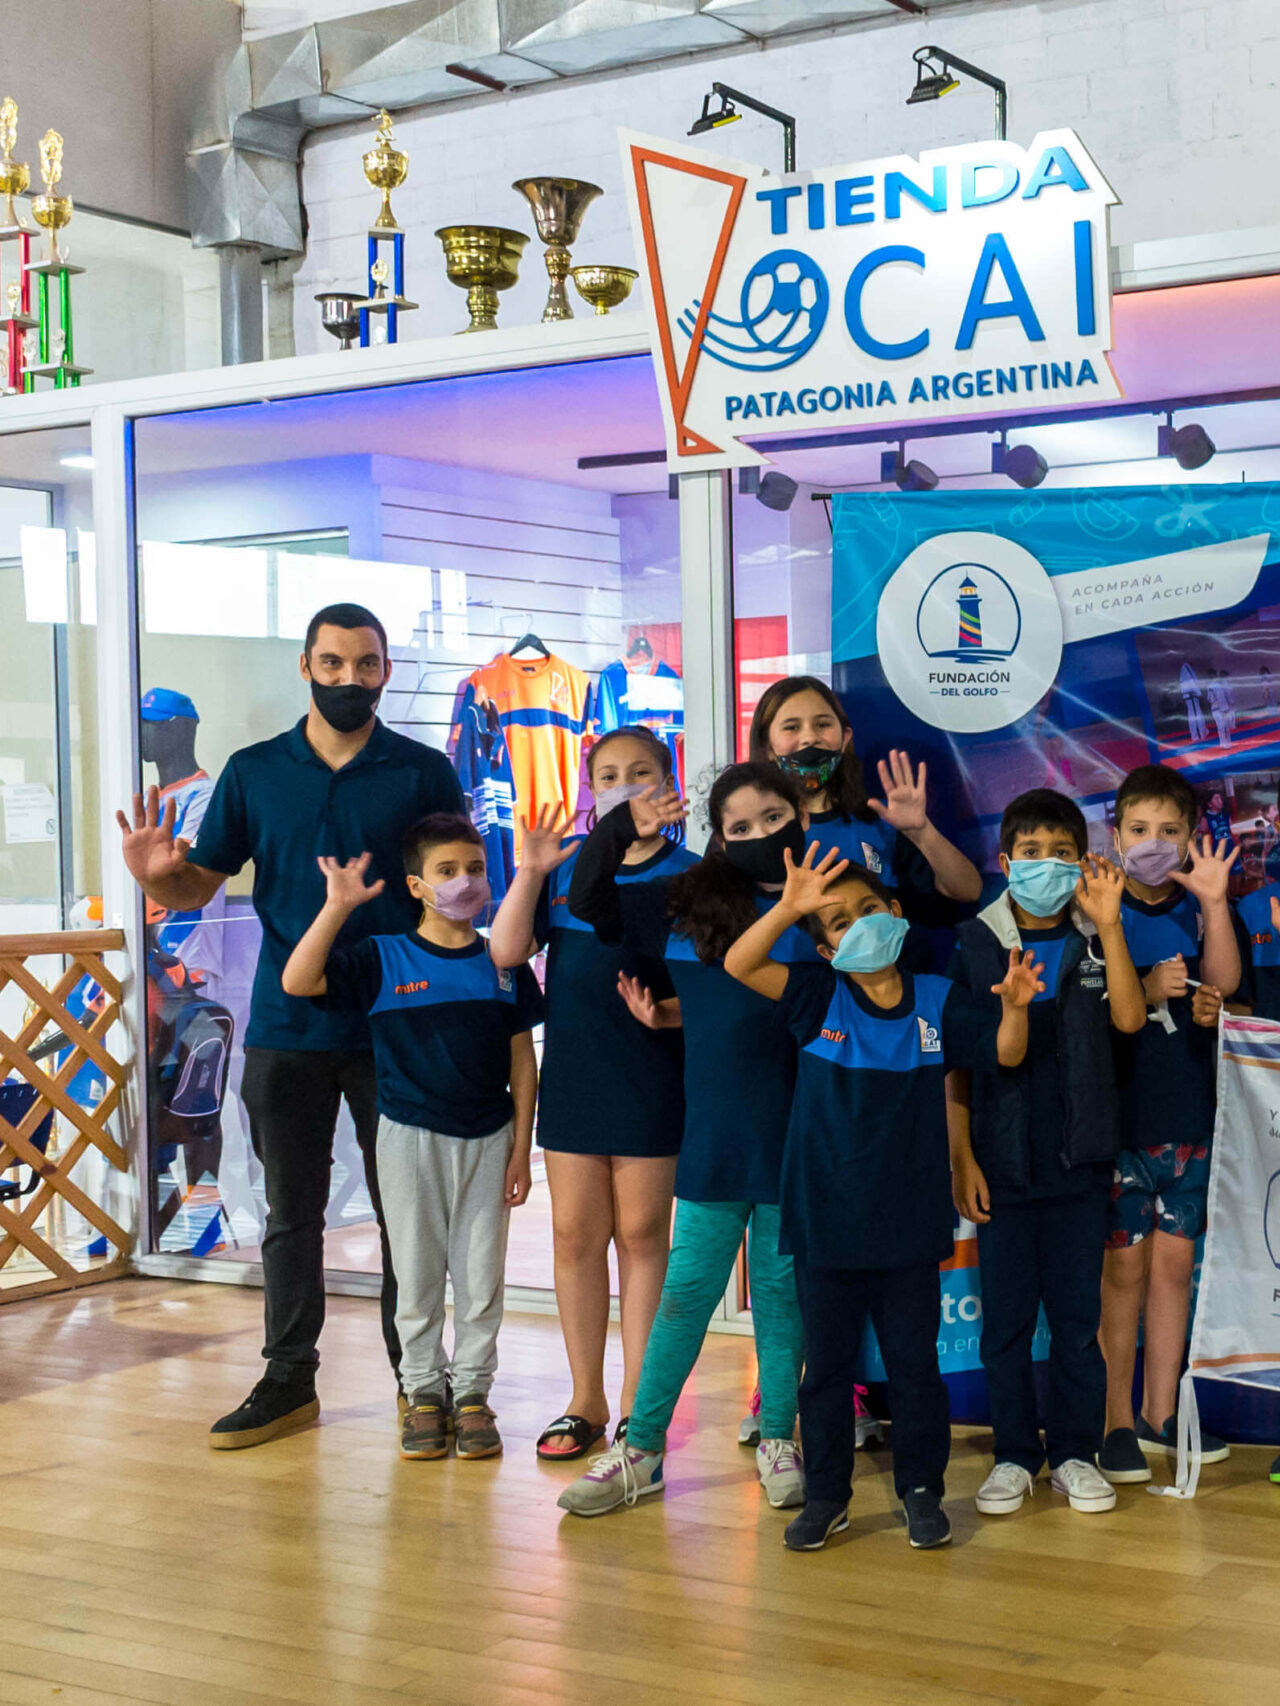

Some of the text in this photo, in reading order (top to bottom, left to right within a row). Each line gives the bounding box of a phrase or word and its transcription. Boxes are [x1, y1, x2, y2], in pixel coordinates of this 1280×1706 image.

[755, 146, 1089, 235] TIENDA
[725, 359, 1098, 421] PATAGONIA ARGENTINA
[1072, 574, 1164, 598] ACOMPAÑA
[1075, 582, 1215, 616] EN CADA ACCIÓN
[929, 669, 1011, 684] FUNDACIÓN
[941, 687, 999, 697] DEL GOLFO
[820, 1028, 847, 1043] mitr
[1269, 1109, 1279, 1121] Y
